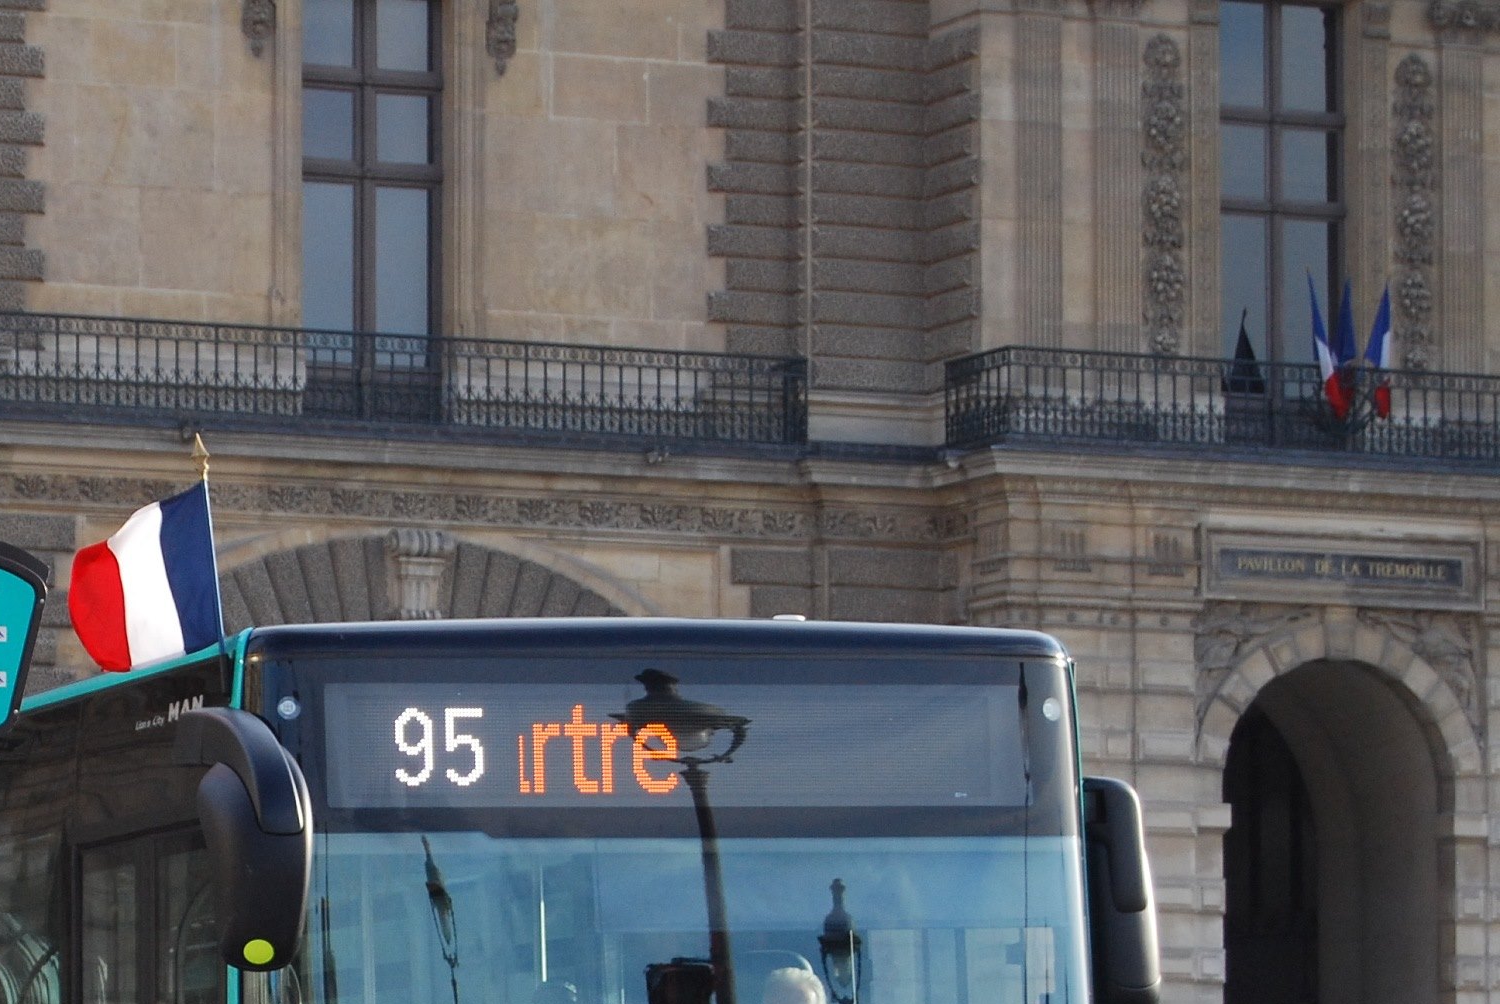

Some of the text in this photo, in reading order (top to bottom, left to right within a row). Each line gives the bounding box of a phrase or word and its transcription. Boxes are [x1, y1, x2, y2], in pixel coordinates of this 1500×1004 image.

[1315, 559, 1332, 575] DE
[1342, 561, 1361, 576] LA
[168, 694, 204, 722] MAN
[394, 707, 486, 786] 95
